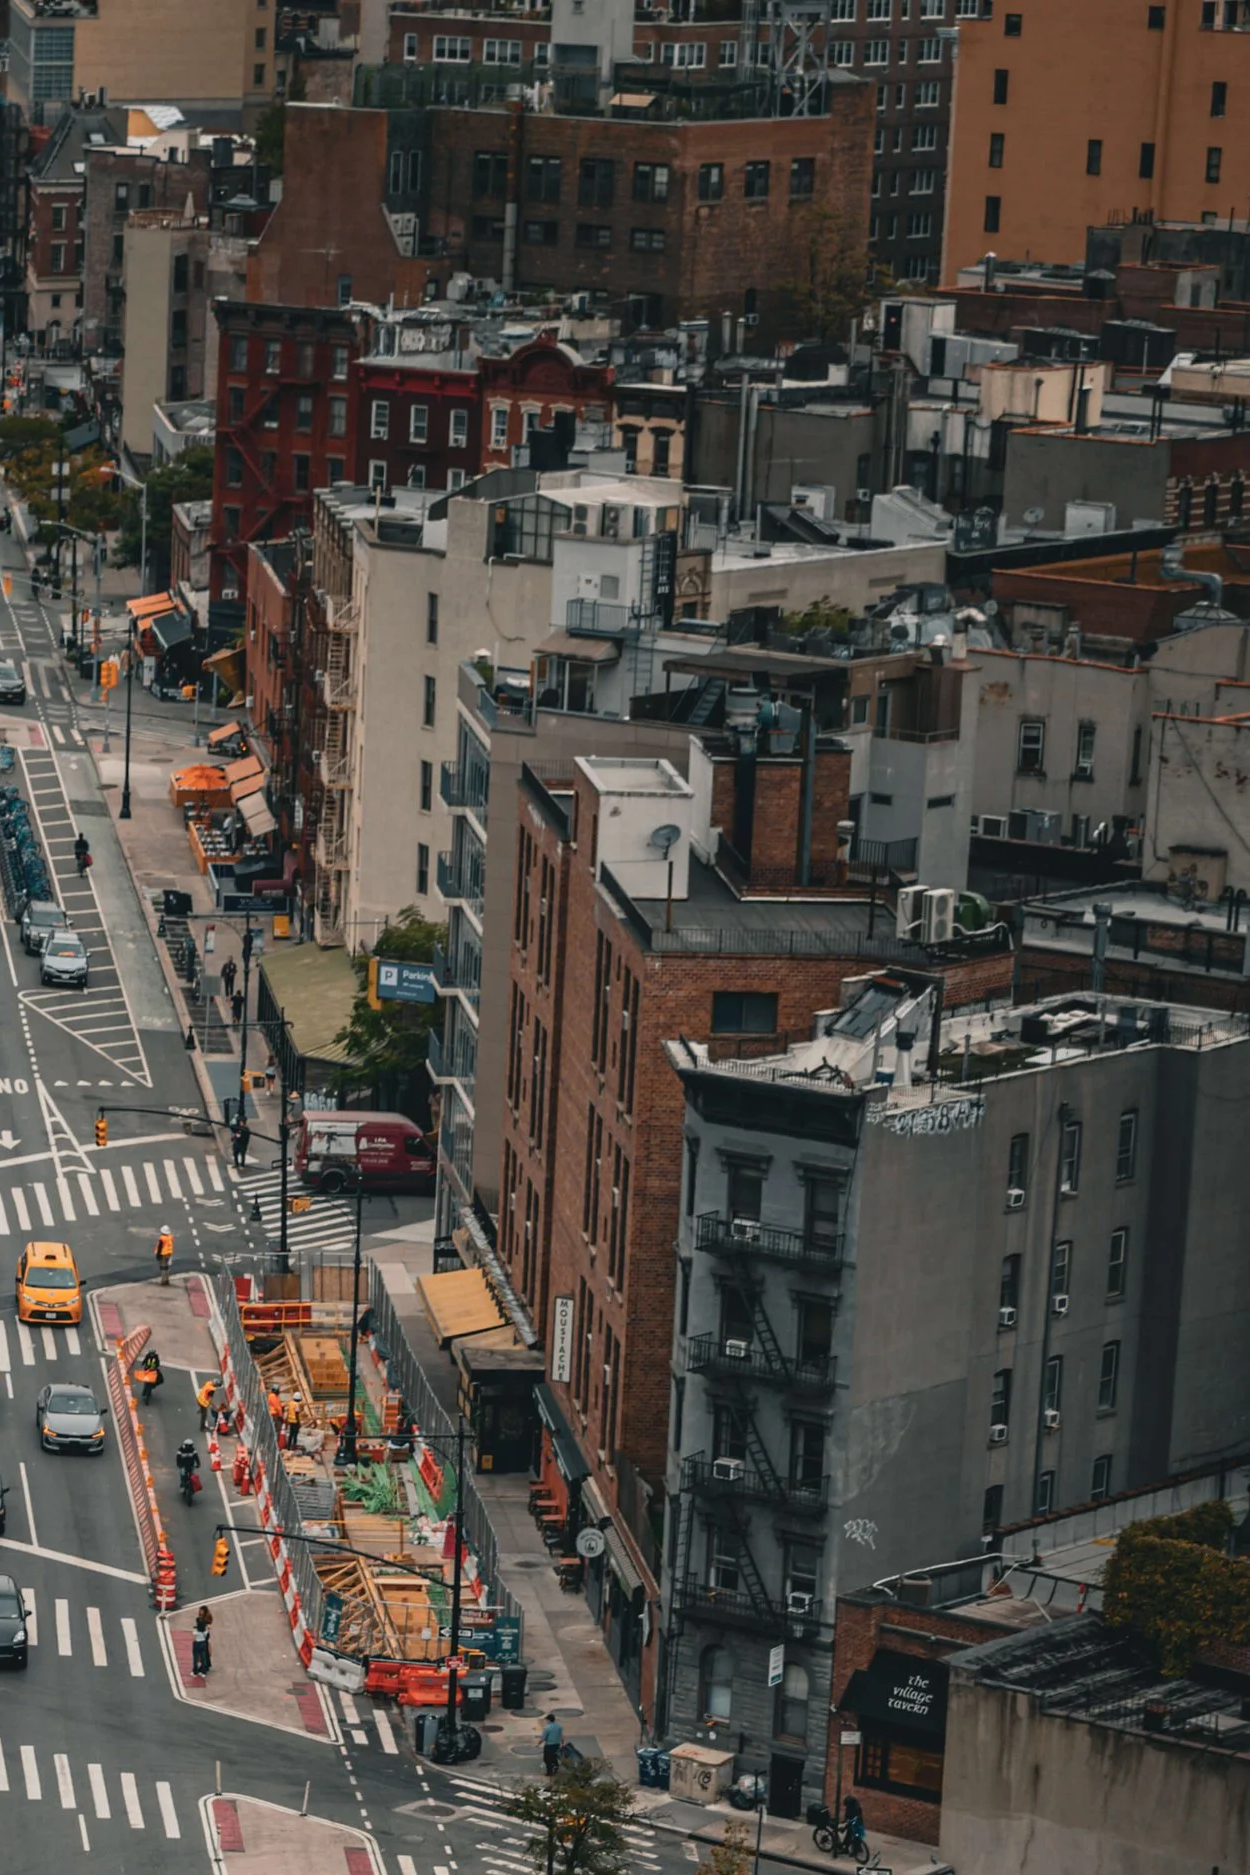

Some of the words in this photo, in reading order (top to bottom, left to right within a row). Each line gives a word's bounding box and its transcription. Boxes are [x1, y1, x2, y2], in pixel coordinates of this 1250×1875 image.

[385, 970, 393, 980] P
[557, 1300, 569, 1380] MOUSTACHE
[908, 1675, 930, 1688] the
[893, 1686, 933, 1704] village
